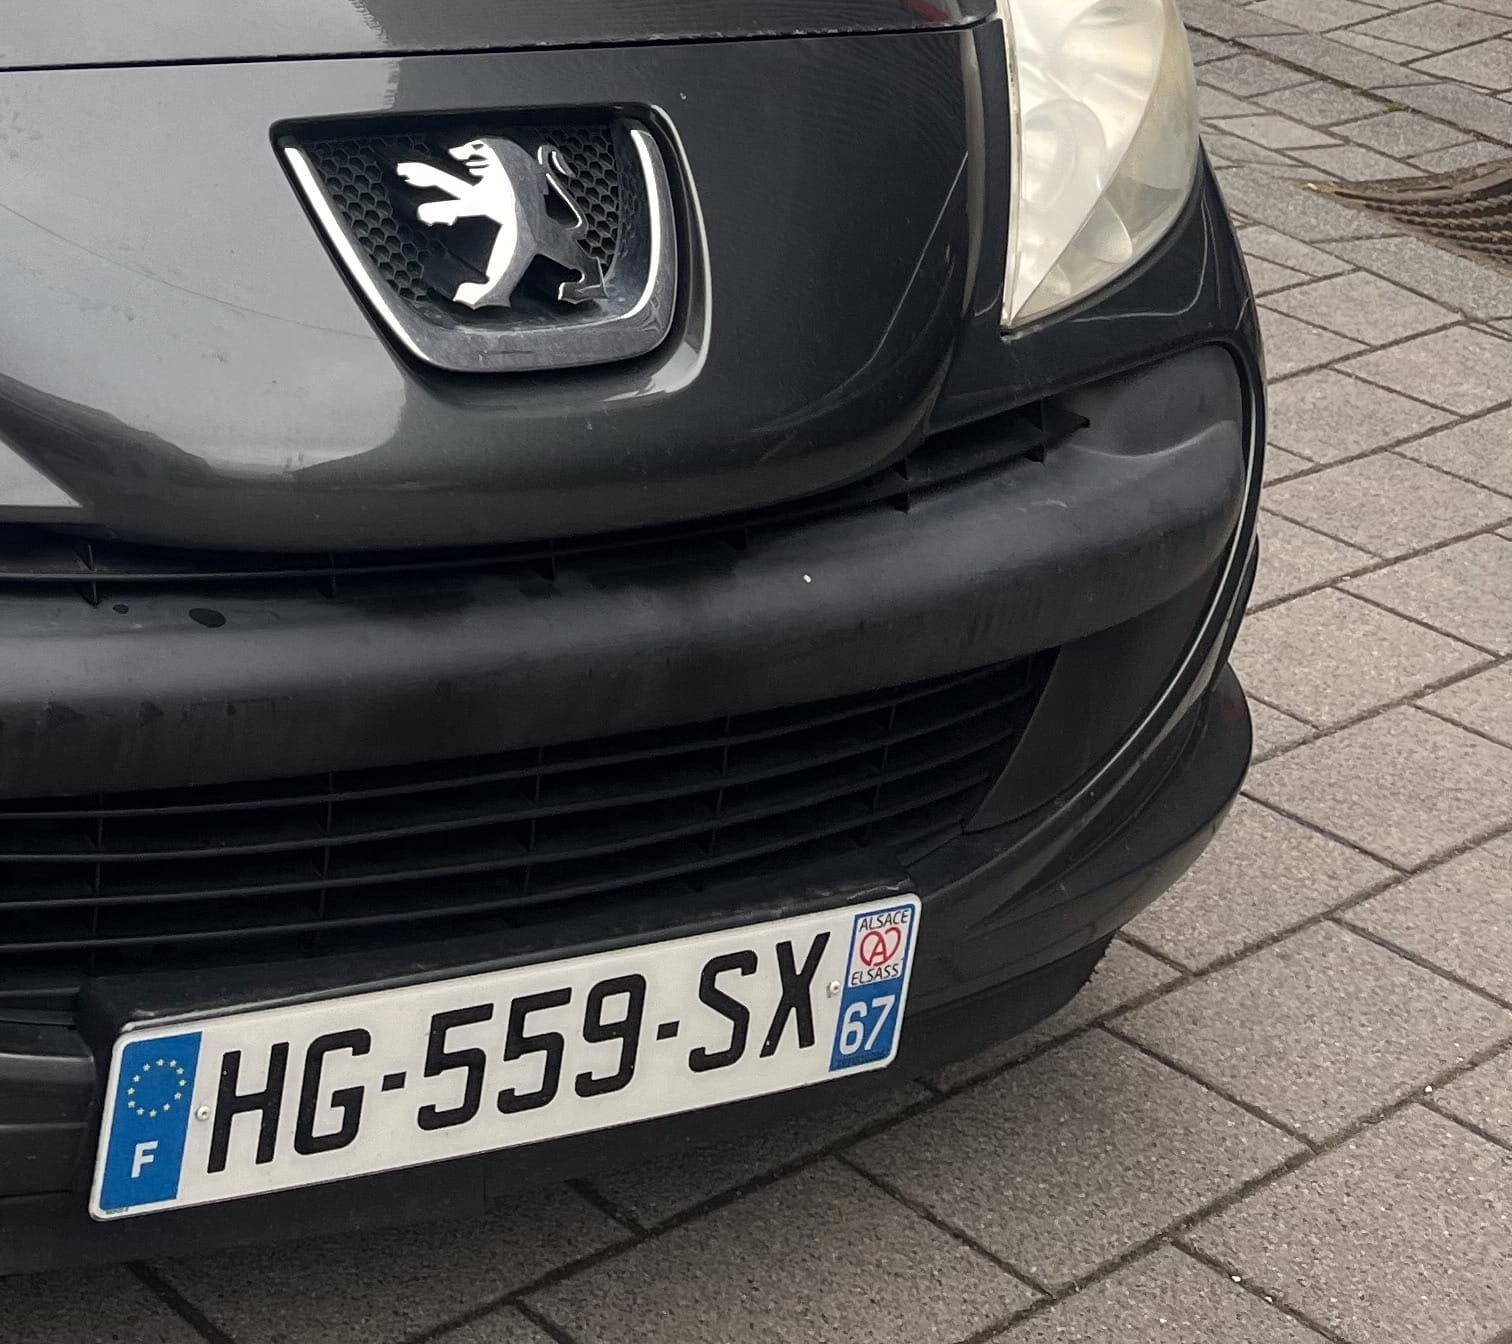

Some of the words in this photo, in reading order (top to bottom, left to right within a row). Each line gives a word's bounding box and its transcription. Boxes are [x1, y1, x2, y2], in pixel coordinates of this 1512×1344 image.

[859, 909, 909, 933] ALSACE
[851, 962, 900, 986] ELSASS
[839, 994, 896, 1055] 67
[205, 931, 832, 1175] HG-559-SX
[131, 1141, 159, 1181] F
